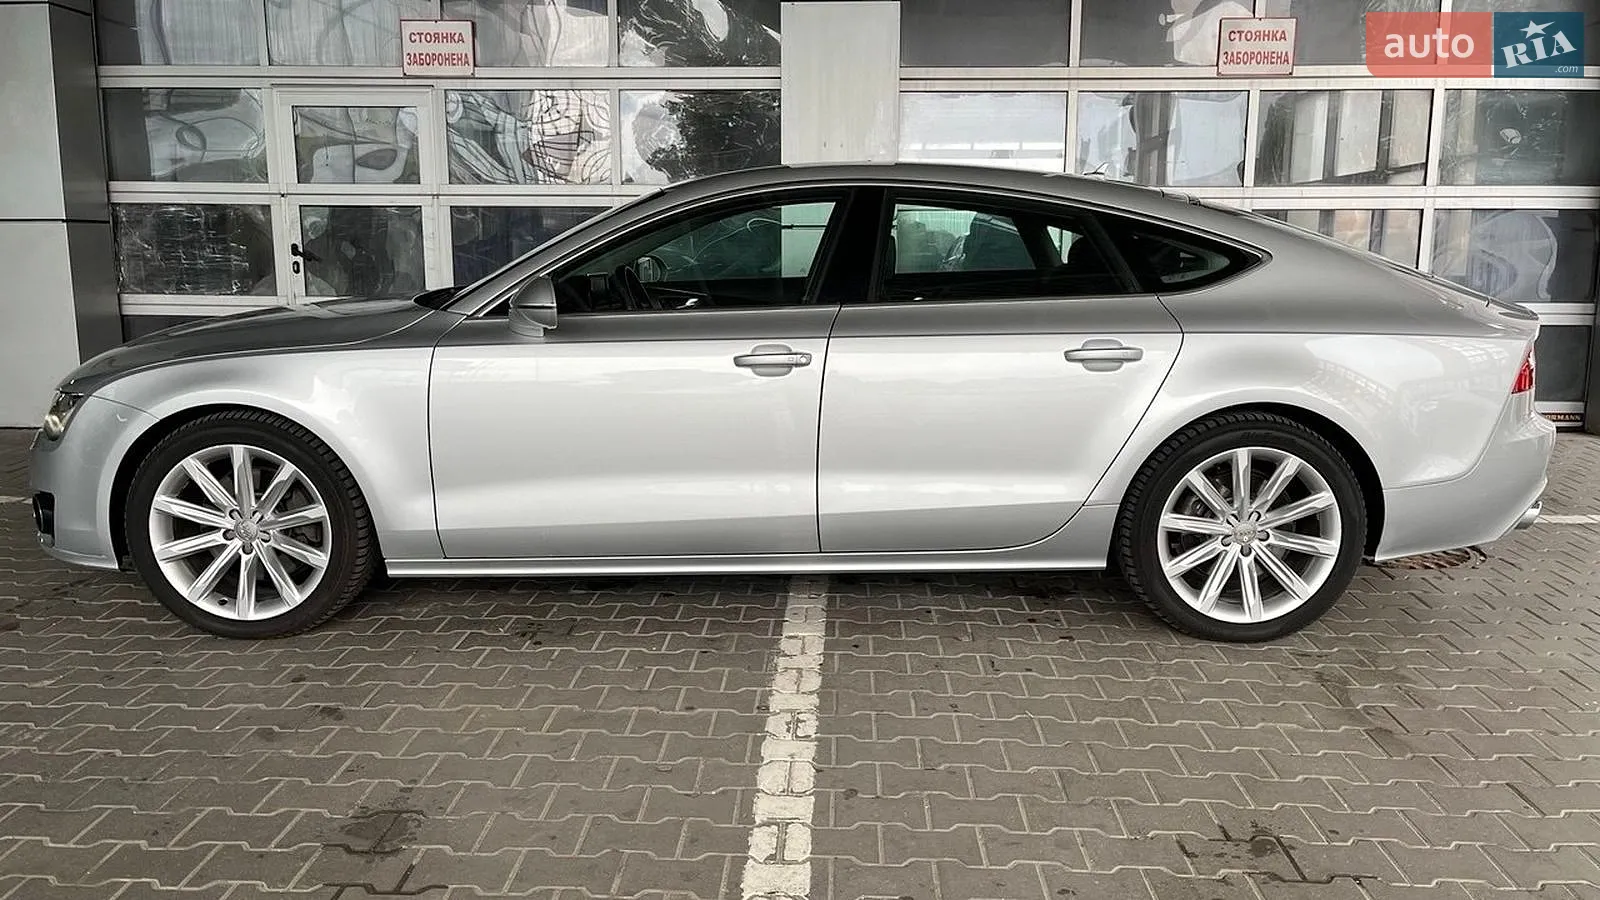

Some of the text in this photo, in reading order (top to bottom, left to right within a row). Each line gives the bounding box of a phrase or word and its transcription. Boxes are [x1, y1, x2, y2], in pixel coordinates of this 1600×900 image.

[409, 31, 465, 43] СТОЯНКА
[1228, 30, 1287, 41] СТОЯНКА
[406, 52, 470, 66] ЗАБОРОНЕНА
[1223, 51, 1290, 65] ЗАБОРОНЕНА
